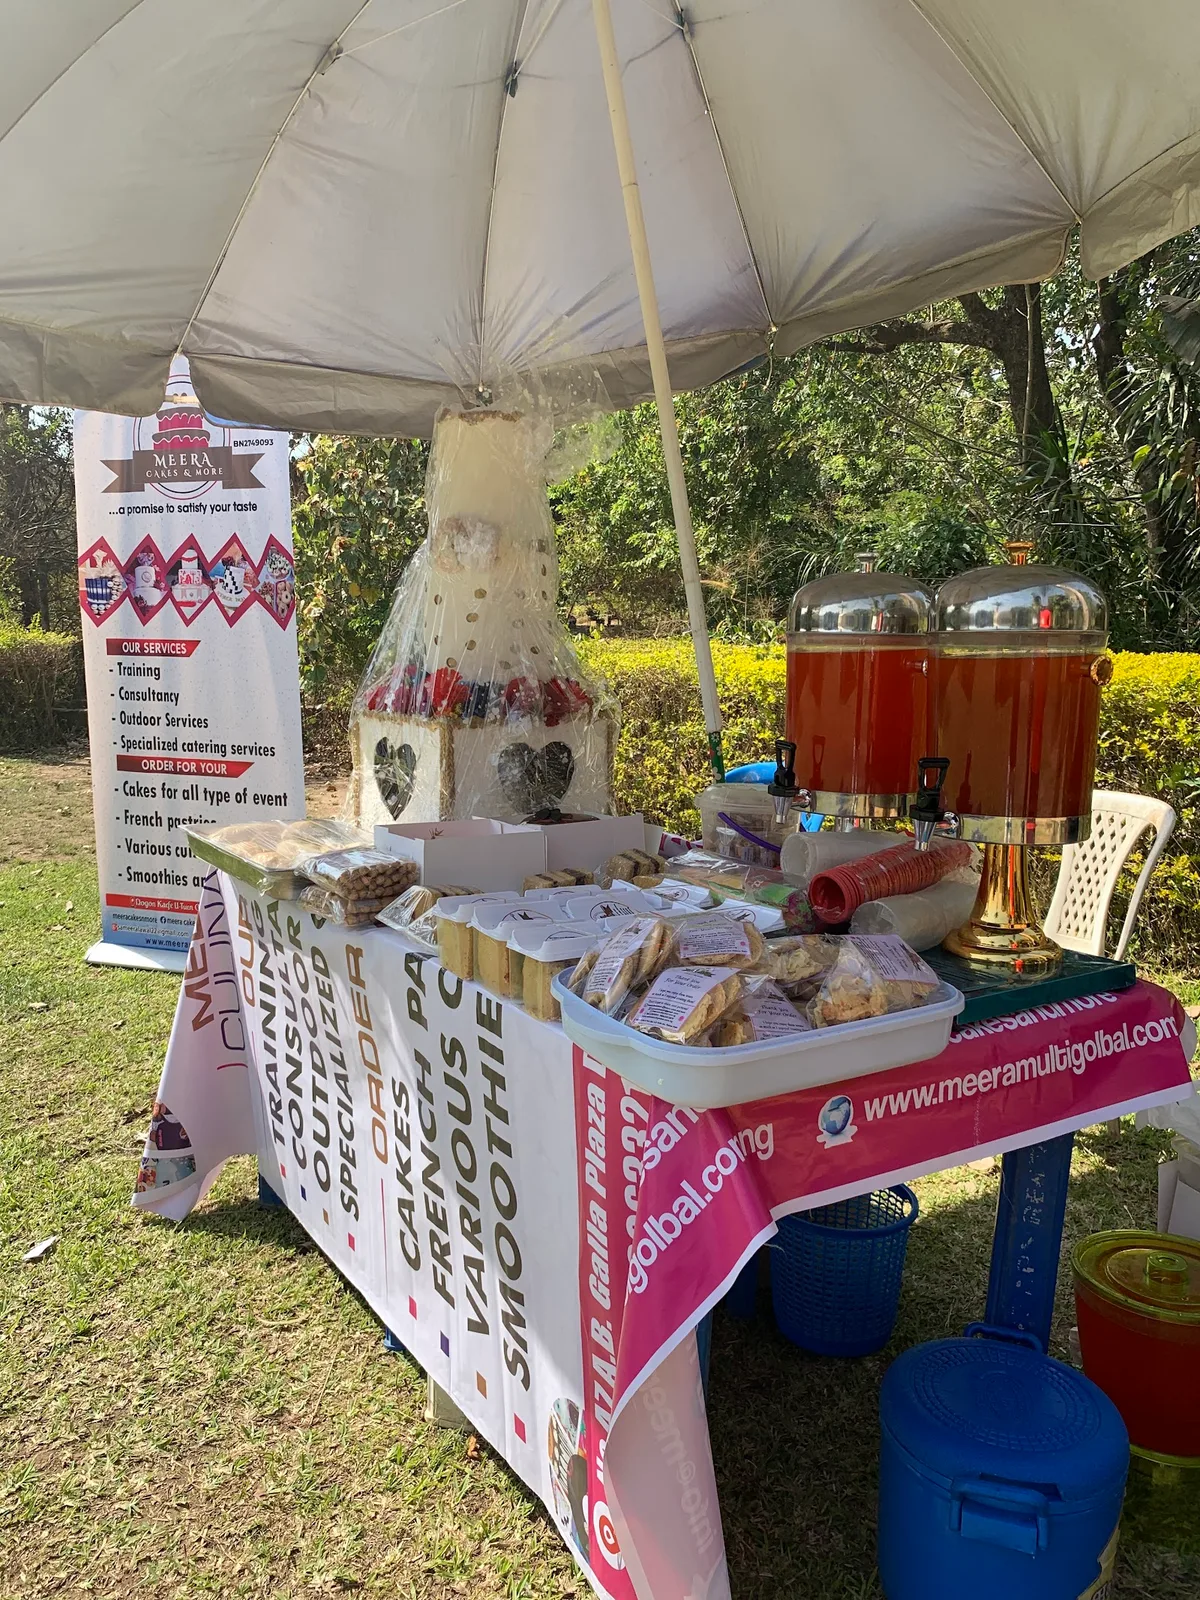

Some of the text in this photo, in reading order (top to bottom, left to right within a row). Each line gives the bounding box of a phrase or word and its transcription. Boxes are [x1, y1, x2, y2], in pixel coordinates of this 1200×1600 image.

[233, 439, 274, 448] BN2749093
[153, 452, 213, 468] MEERA
[146, 467, 223, 479] CAKES & MORE
[127, 503, 164, 517] promise
[166, 503, 175, 513] to
[177, 501, 208, 515] satisfy
[210, 503, 231, 515] your
[233, 501, 258, 512] taste
[122, 642, 187, 655] OUR SERVICES
[117, 662, 161, 680] Training
[118, 686, 180, 706] Consultancy
[119, 711, 209, 729] Outdoor Services
[120, 735, 276, 758] Specialized catering services
[141, 759, 228, 775] ORDER FOR YOUR
[122, 780, 288, 807] Cakes for all type of event
[124, 809, 162, 827] French
[125, 837, 197, 858] Various cui
[126, 866, 188, 887] Smoothies
[145, 938, 191, 949] www.meera
[250, 899, 286, 1146] TRAINING
[285, 911, 332, 1193] OUTDOOR
[345, 943, 389, 1165] ORDER
[863, 1015, 1180, 1122] www.meeramultigolbal.com
[310, 945, 360, 1222] SPECIALIZED
[584, 1081, 608, 1200] Plaza
[390, 1076, 422, 1273] CAKES
[414, 1048, 456, 1308] FRENCH
[439, 1032, 490, 1335] VARIOUS
[475, 991, 531, 1392] SMOOTHIE
[586, 1199, 611, 1311] Galla
